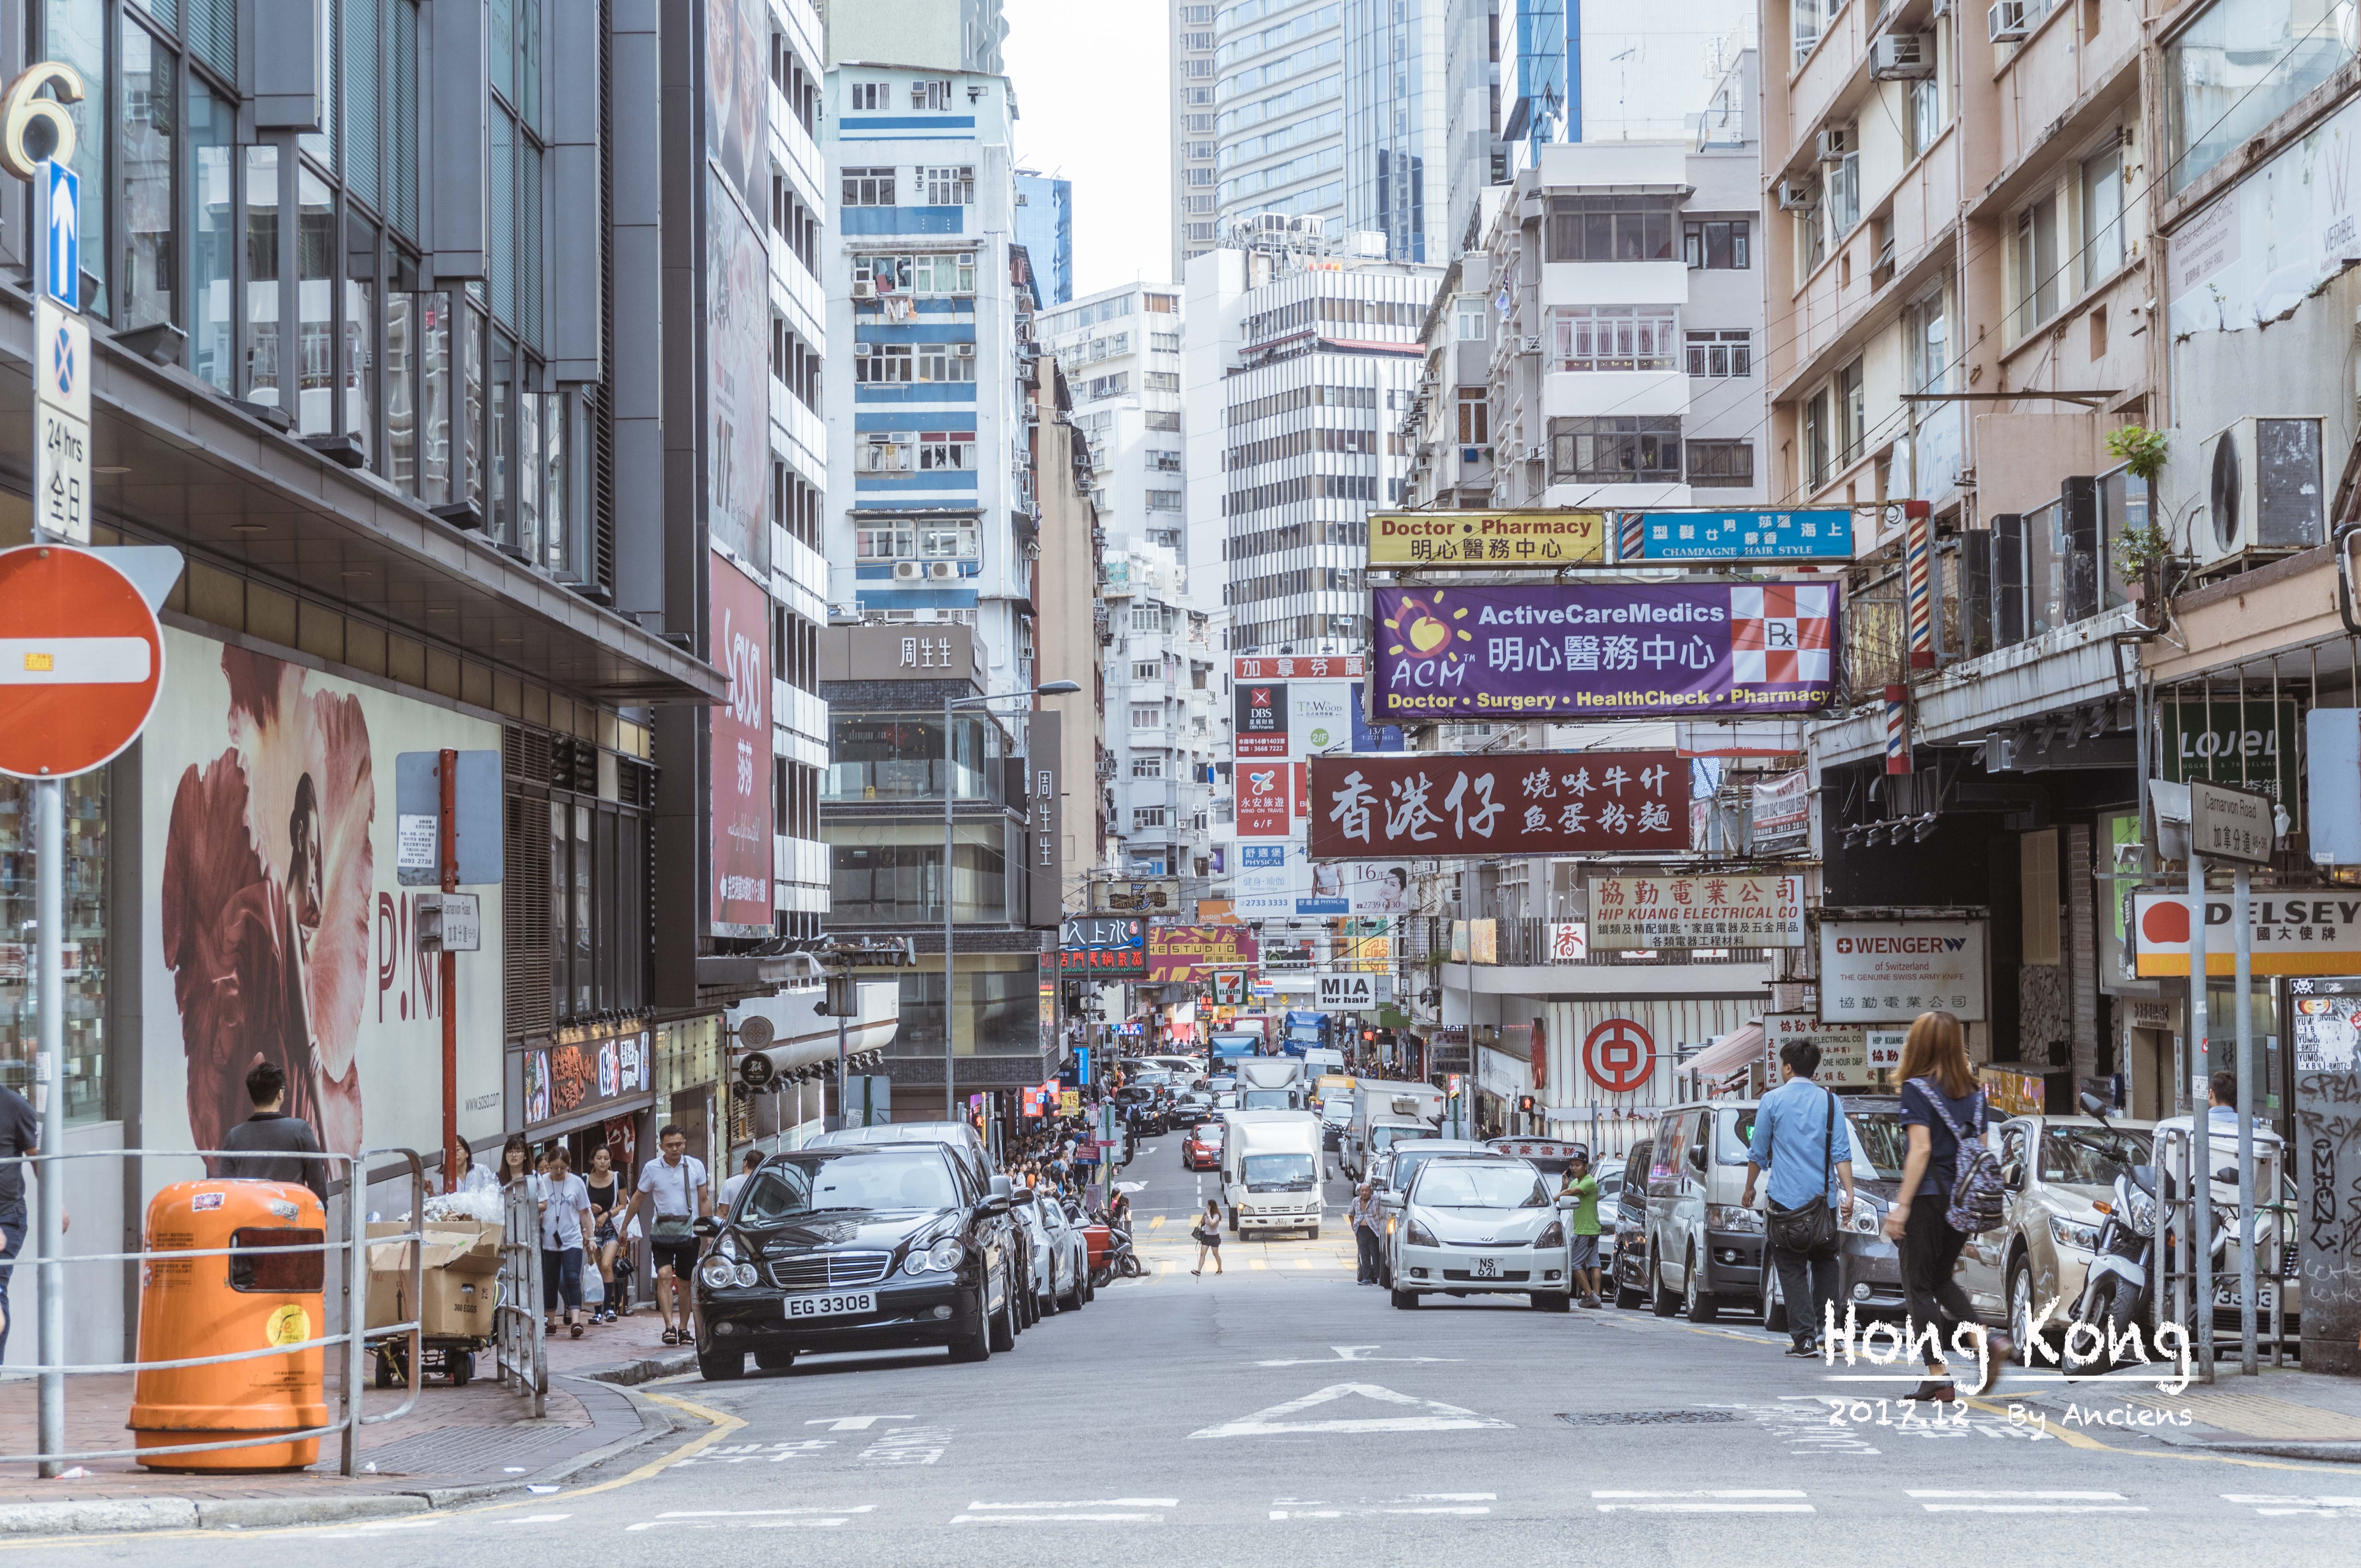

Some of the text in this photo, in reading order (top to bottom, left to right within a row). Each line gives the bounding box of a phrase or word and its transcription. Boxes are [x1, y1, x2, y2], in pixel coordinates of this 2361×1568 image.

[48, 418, 83, 463] 24 hrs
[51, 470, 80, 527] 全日
[1382, 519, 1592, 537] Doctor Pharmacy
[1411, 538, 1562, 559] 明心醫務中心
[1662, 546, 1812, 556] CHAMPAGNE HAIR STYLE
[1479, 604, 1725, 625] ActiveCareMedics
[900, 637, 952, 668] 周生生
[1488, 635, 1716, 673] 明心醫務中心
[1391, 660, 1467, 689] ACM
[1388, 689, 1830, 712] Doctor Surgery HealthCheck Pharmacy
[1251, 708, 1272, 718] DBS
[1312, 733, 1327, 743] 2/F
[738, 738, 752, 797] 莎莎
[1521, 763, 1670, 800] 燒味牛什
[1241, 797, 1285, 808] 永安旅遊
[1329, 770, 1506, 844] 香港仔
[2205, 792, 2256, 819] Carnarvon Road
[1036, 769, 1052, 867] 周生生
[1777, 823, 1790, 833] 2813
[1793, 820, 1806, 829] 2811
[2214, 824, 2250, 854] 加拿分道
[1245, 848, 1282, 858] 舒適堡
[1598, 878, 1796, 905] 協勤電業公司
[462, 901, 471, 915] Road
[1362, 901, 1381, 909] 2739
[1597, 906, 1798, 920] HIP KUANG ELECTRICAL CO
[1597, 921, 1799, 935] 鎖類及精配鎖匙 家庭電器及五金用品
[1652, 935, 1744, 947] 各類電器工程材料
[1856, 937, 1944, 954] WENGER
[1875, 961, 1929, 971] of Switzerland
[1322, 978, 1369, 994] MIA
[1839, 996, 1966, 1008] 協勤電業公司
[1767, 1038, 1777, 1083] 五金用品
[1852, 1057, 1863, 1066] D&P
[1871, 1049, 1898, 1062] 協勤
[1436, 1062, 1457, 1071] MIA
[465, 1092, 500, 1113] www.sasa.com
[1498, 1144, 1575, 1156] 富豪雪糕
[1480, 1258, 1494, 1268] NS
[1478, 1267, 1496, 1277] 621
[454, 1304, 477, 1313] 360 EGGS
[790, 1295, 870, 1316] EG 3308
